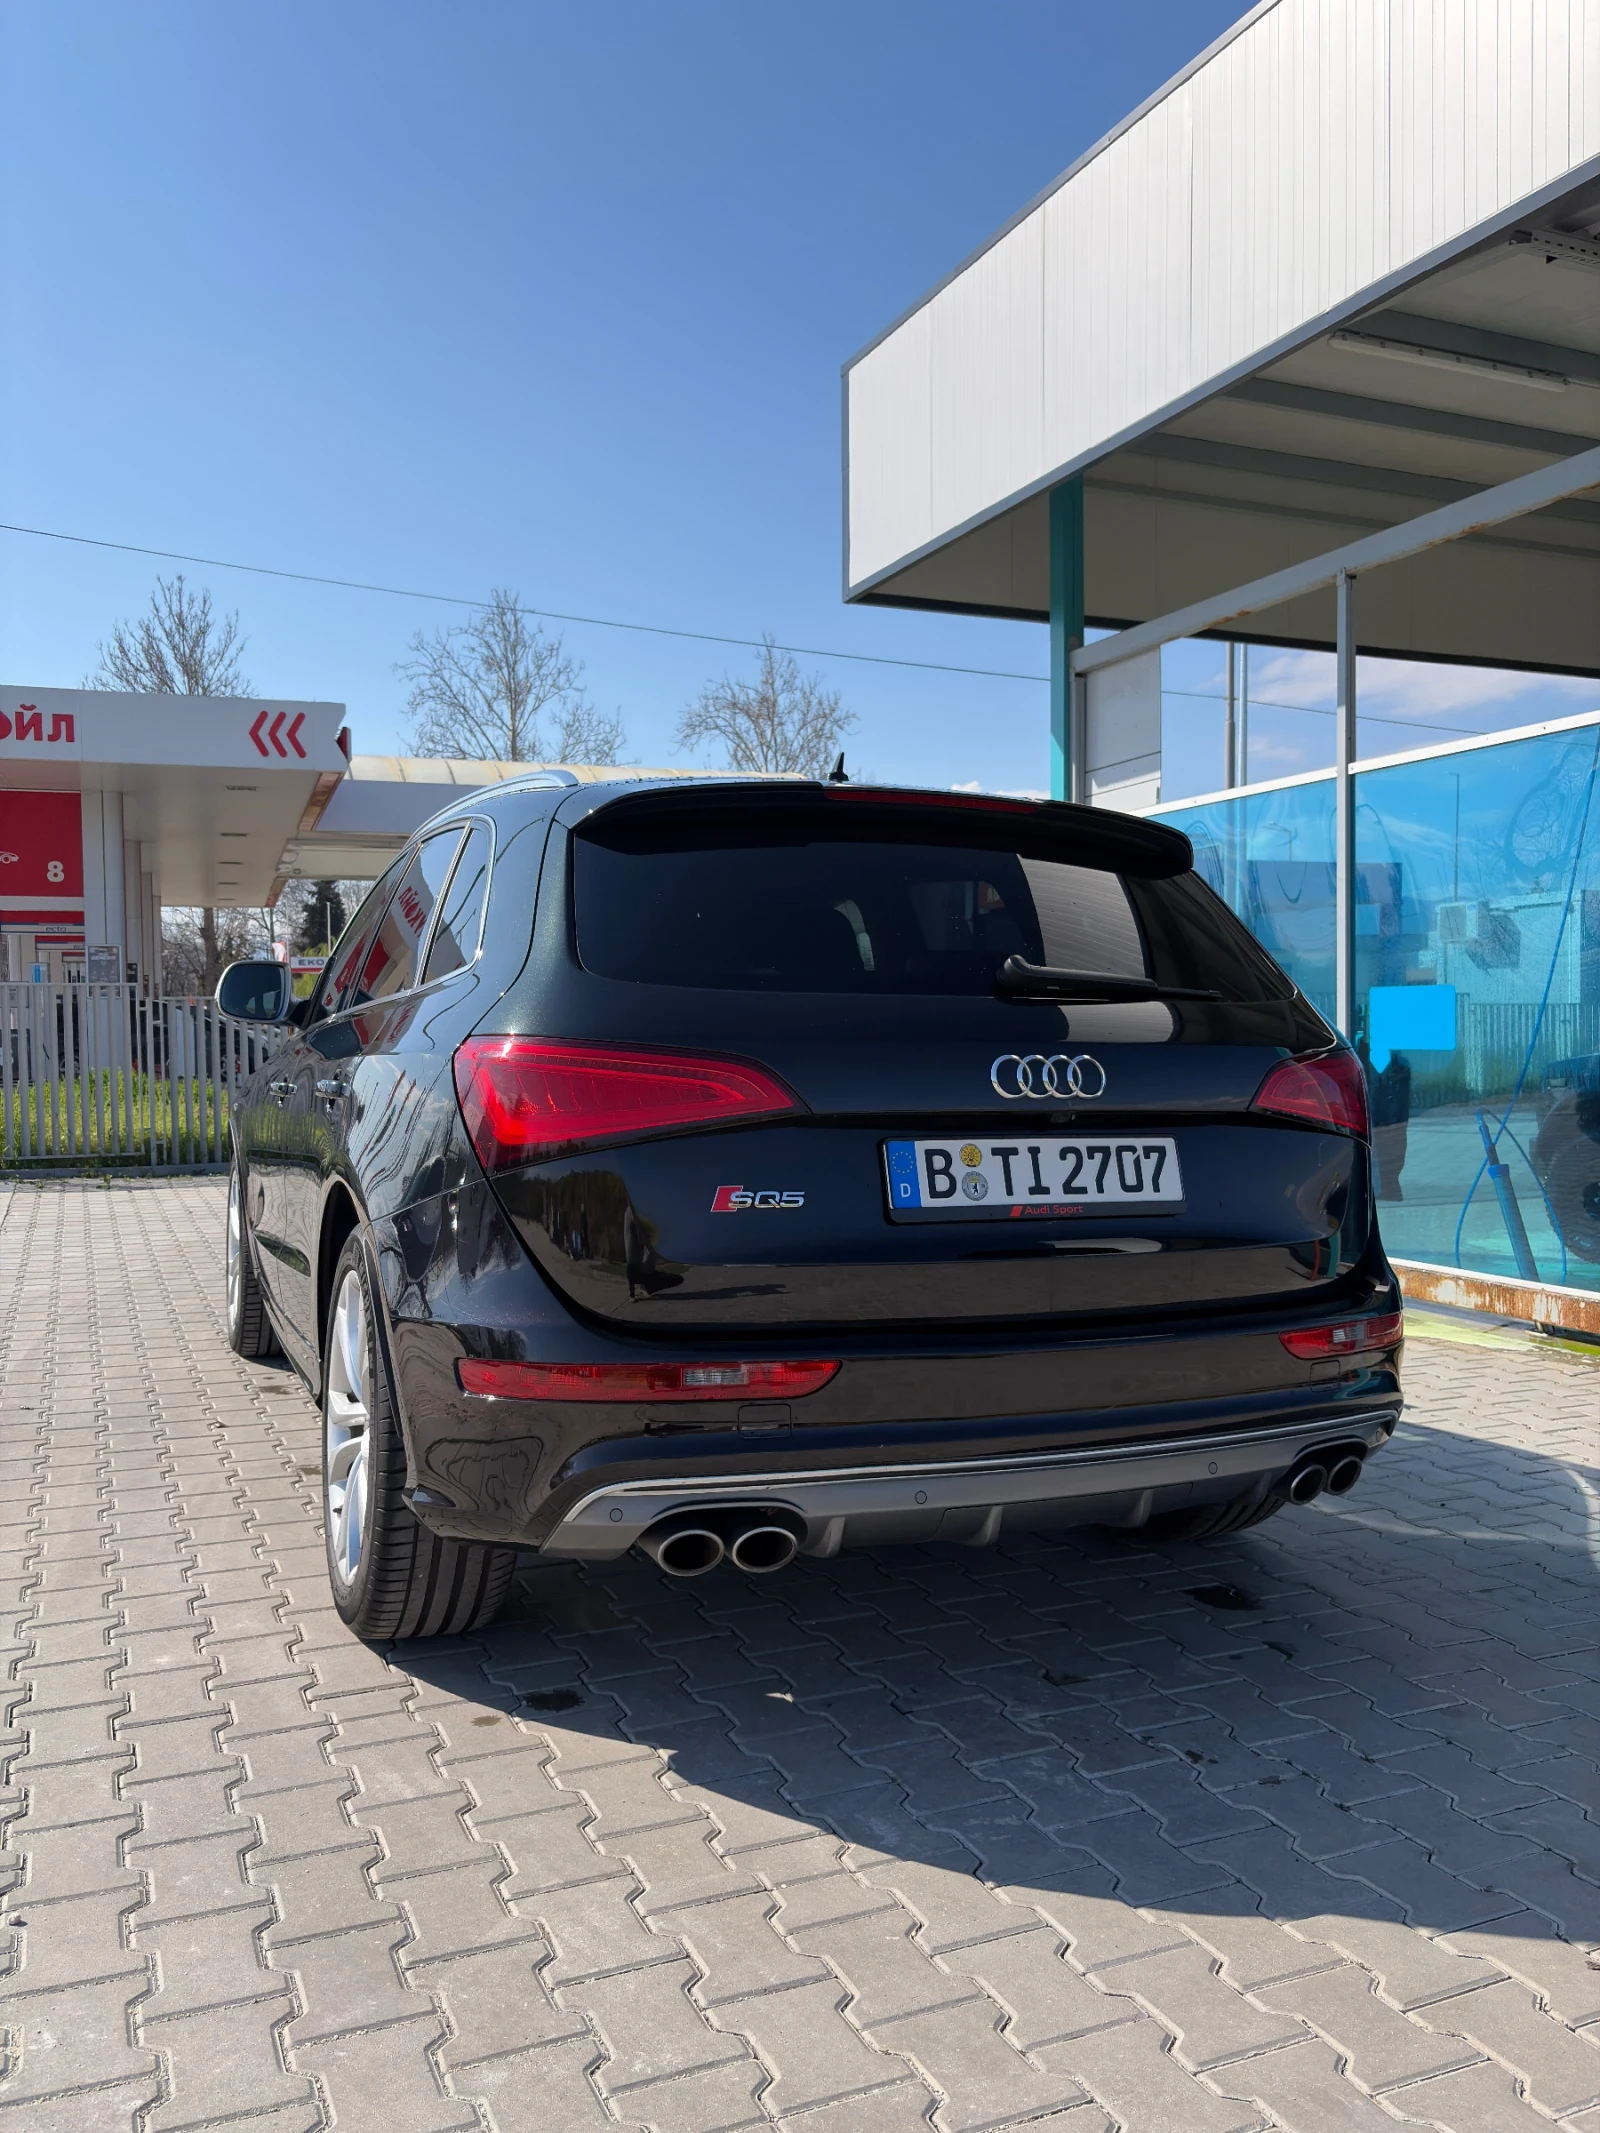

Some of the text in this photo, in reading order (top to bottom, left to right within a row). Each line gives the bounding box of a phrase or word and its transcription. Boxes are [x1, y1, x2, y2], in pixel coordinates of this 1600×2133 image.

[47, 861, 64, 882] 8
[925, 1149, 957, 1199] B
[901, 1183, 911, 1198] D
[728, 1191, 805, 1208] SQ5
[1025, 1204, 1083, 1215] Audi Sport
